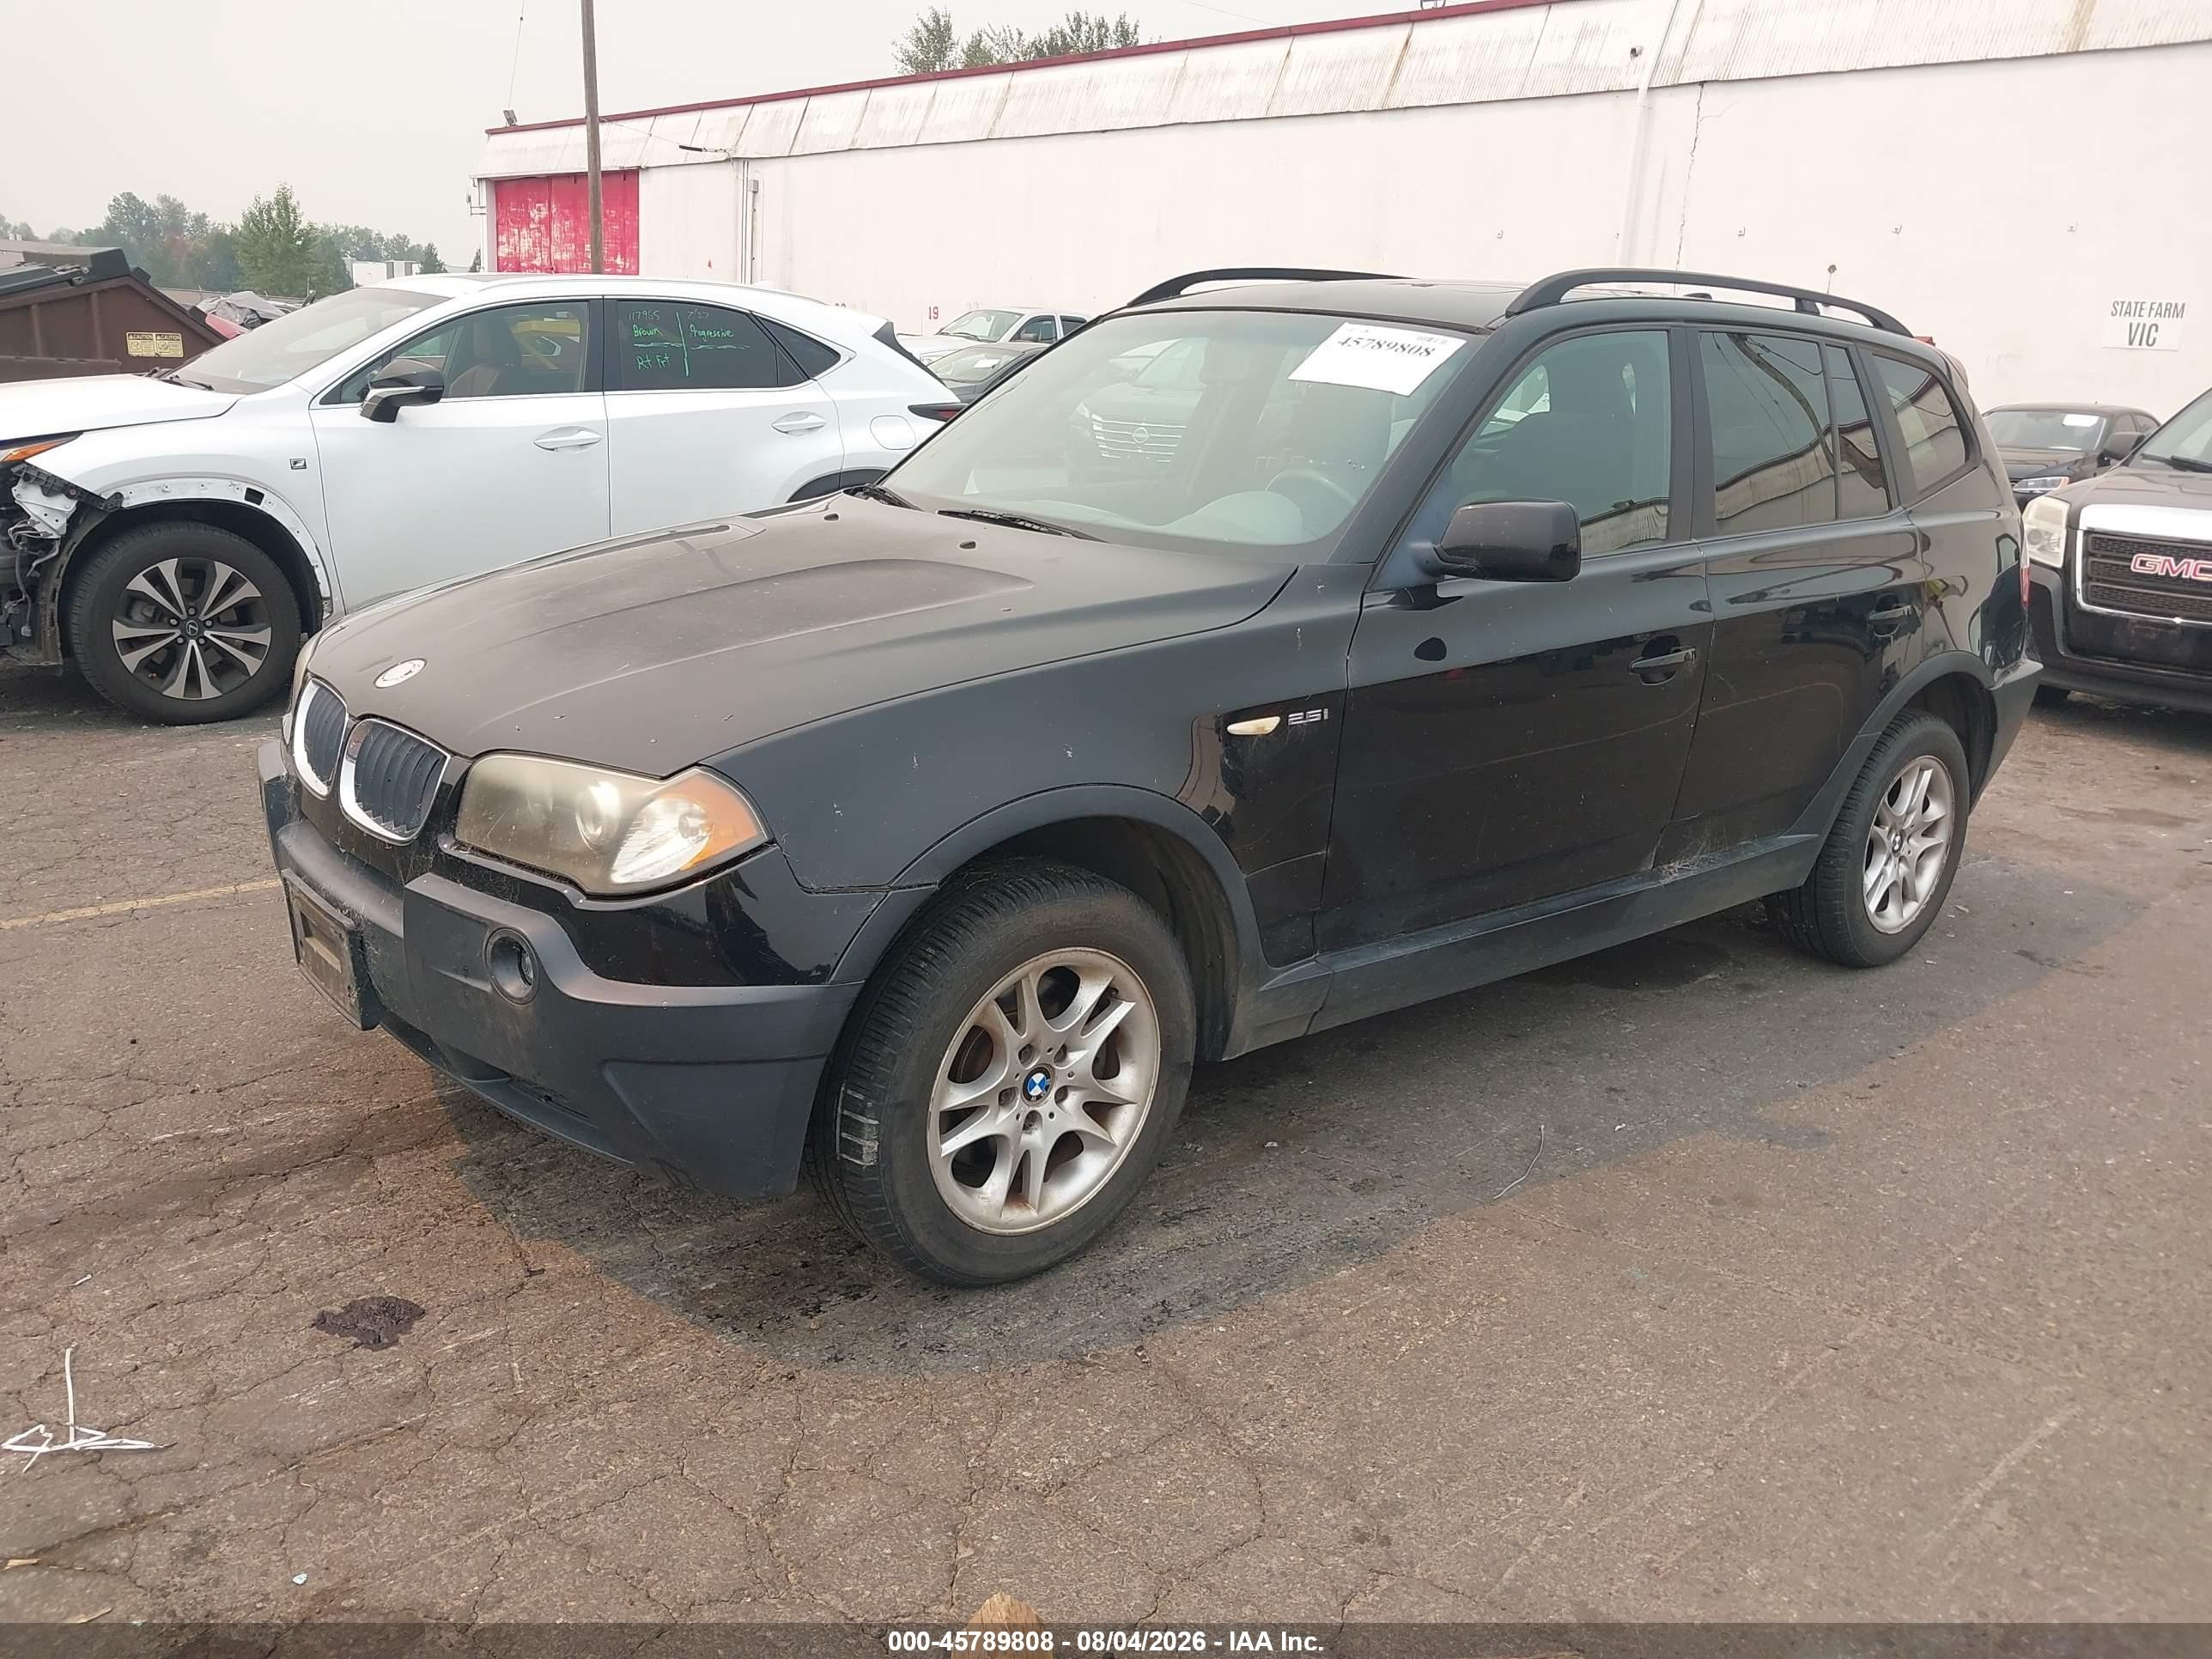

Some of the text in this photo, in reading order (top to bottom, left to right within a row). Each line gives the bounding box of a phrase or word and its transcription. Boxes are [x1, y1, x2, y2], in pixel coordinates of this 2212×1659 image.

[928, 306, 939, 320] 19
[2111, 301, 2186, 319] STATE FARM
[632, 324, 665, 337] Brown
[690, 324, 735, 343] Progressive
[2128, 322, 2160, 347] VIC
[1338, 336, 1436, 357] 45789808
[2130, 553, 2212, 582] GMC
